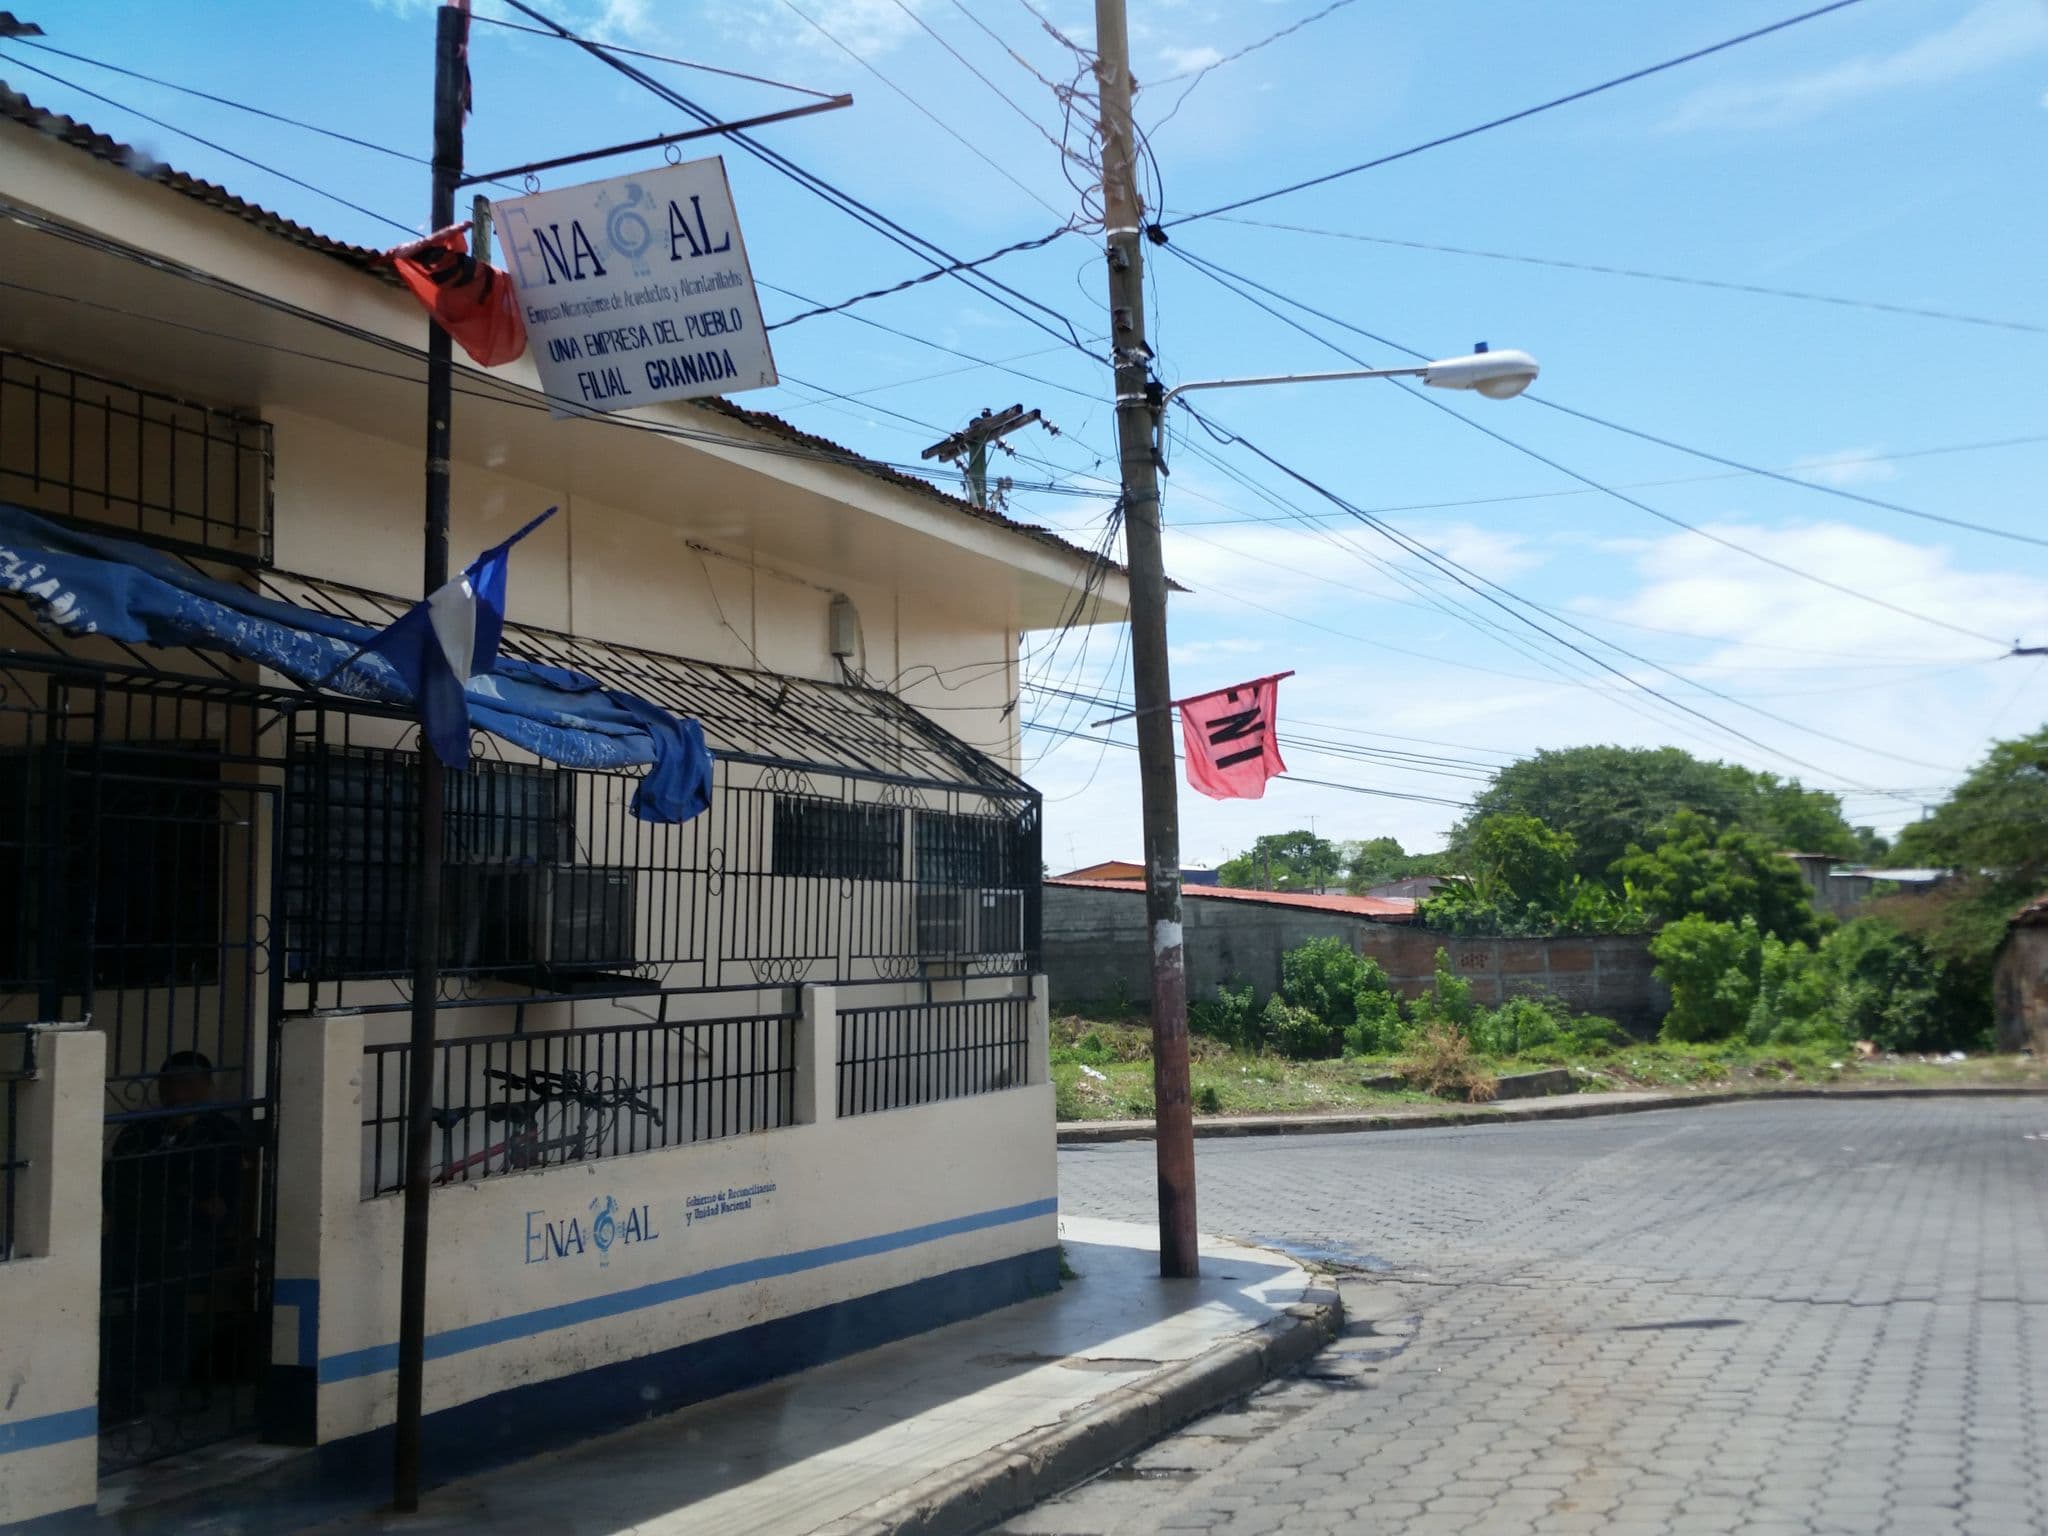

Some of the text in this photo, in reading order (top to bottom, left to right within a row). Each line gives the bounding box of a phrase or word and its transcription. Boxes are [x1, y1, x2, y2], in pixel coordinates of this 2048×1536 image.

[526, 305, 561, 325] Empresa
[610, 291, 622, 310] de
[672, 286, 679, 303] y
[680, 270, 743, 296] Alcantarillados
[548, 307, 743, 363] UNA EMPRESA DEL PUEBLO
[578, 349, 738, 401] FILIAL GRANADA
[686, 1195, 716, 1207] Gobierno
[718, 1191, 725, 1201] de
[686, 1198, 752, 1227] y Unidad Nacional
